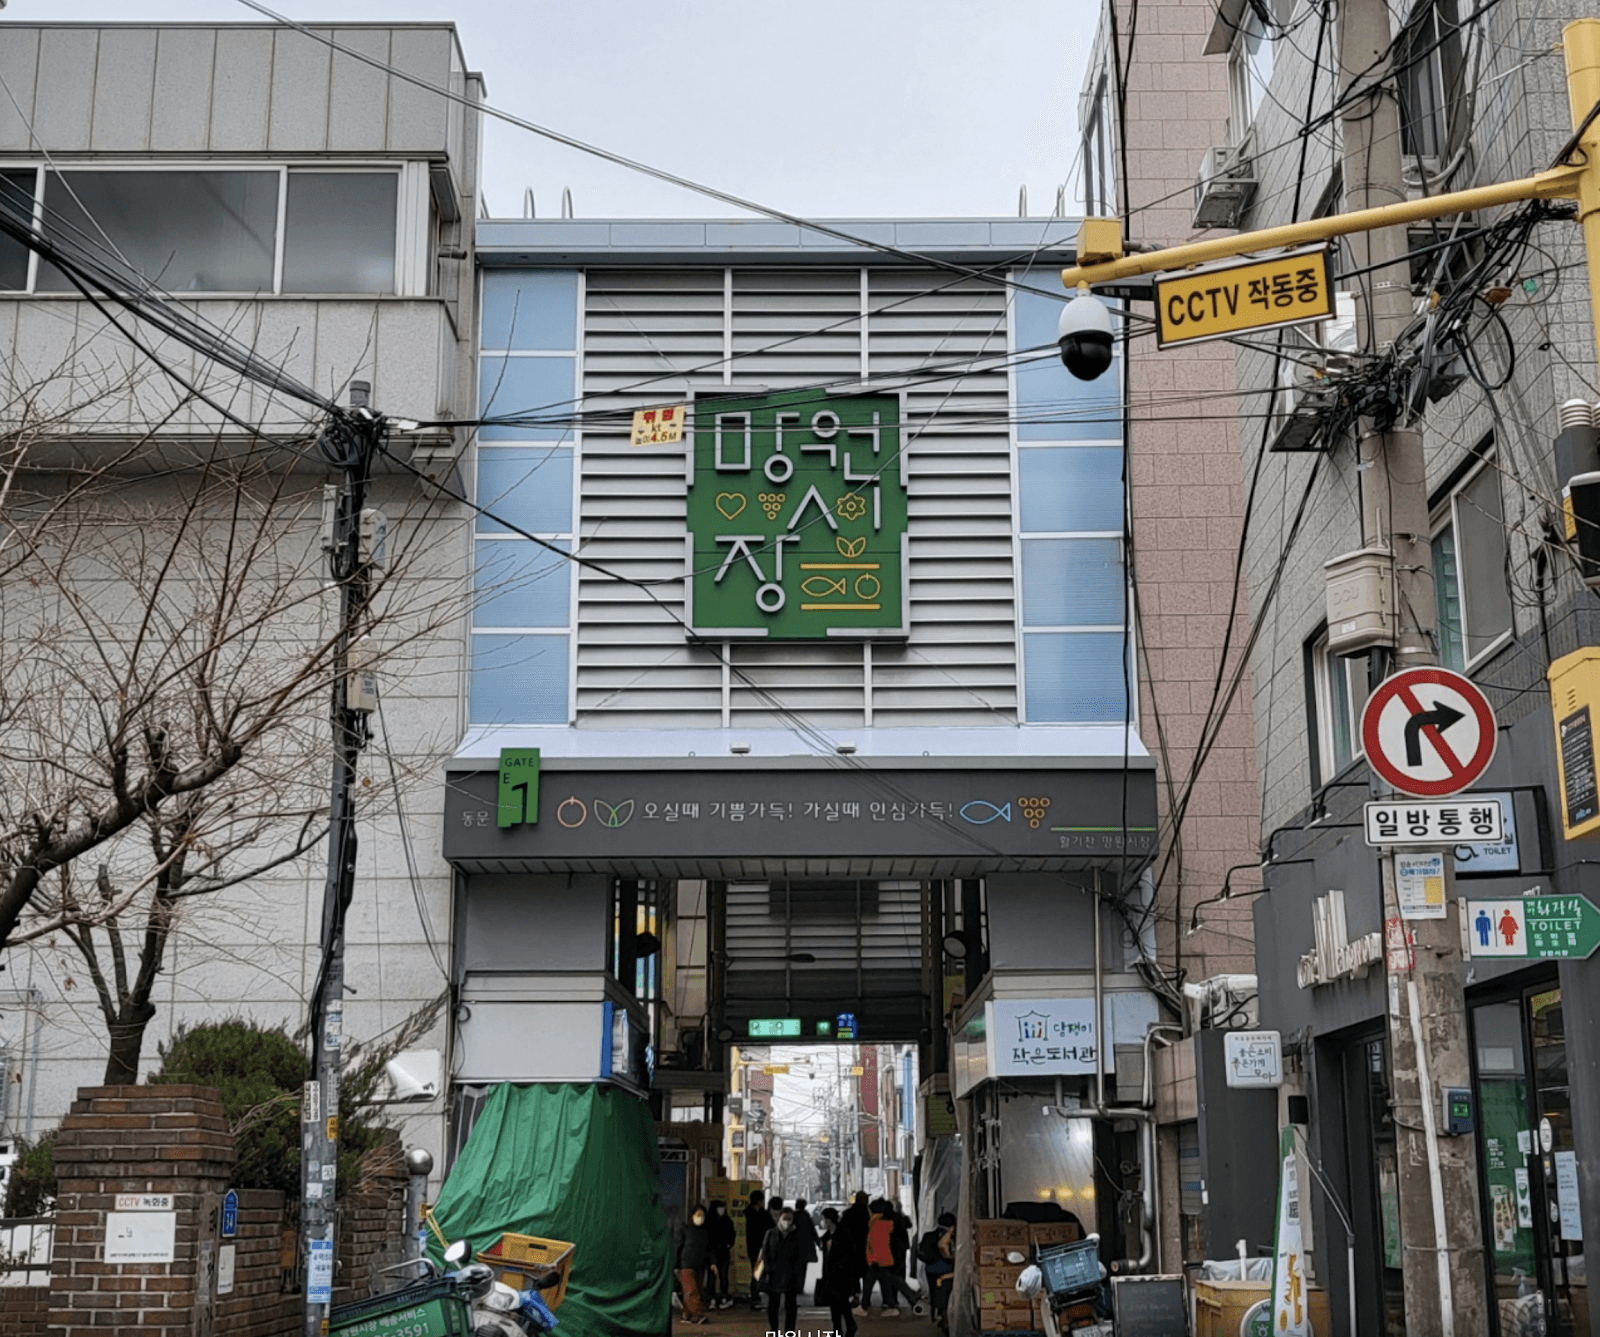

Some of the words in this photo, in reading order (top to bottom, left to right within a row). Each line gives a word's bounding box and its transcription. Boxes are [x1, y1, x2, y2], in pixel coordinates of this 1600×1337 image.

[1168, 284, 1239, 326] CCTV
[1248, 268, 1318, 310] 작동중
[504, 757, 534, 768] GATE
[462, 810, 489, 827] 동문
[642, 801, 700, 822] 오실때
[709, 801, 793, 822] 기쁨가득!
[803, 801, 860, 822] 가실때
[869, 800, 953, 822] 인심가득!
[1375, 807, 1493, 837] 일방통행
[1483, 847, 1512, 856] TOILET
[1529, 921, 1581, 932] TOILET
[1012, 1046, 1097, 1065] 작은도서관
[118, 1196, 140, 1207] CCTV
